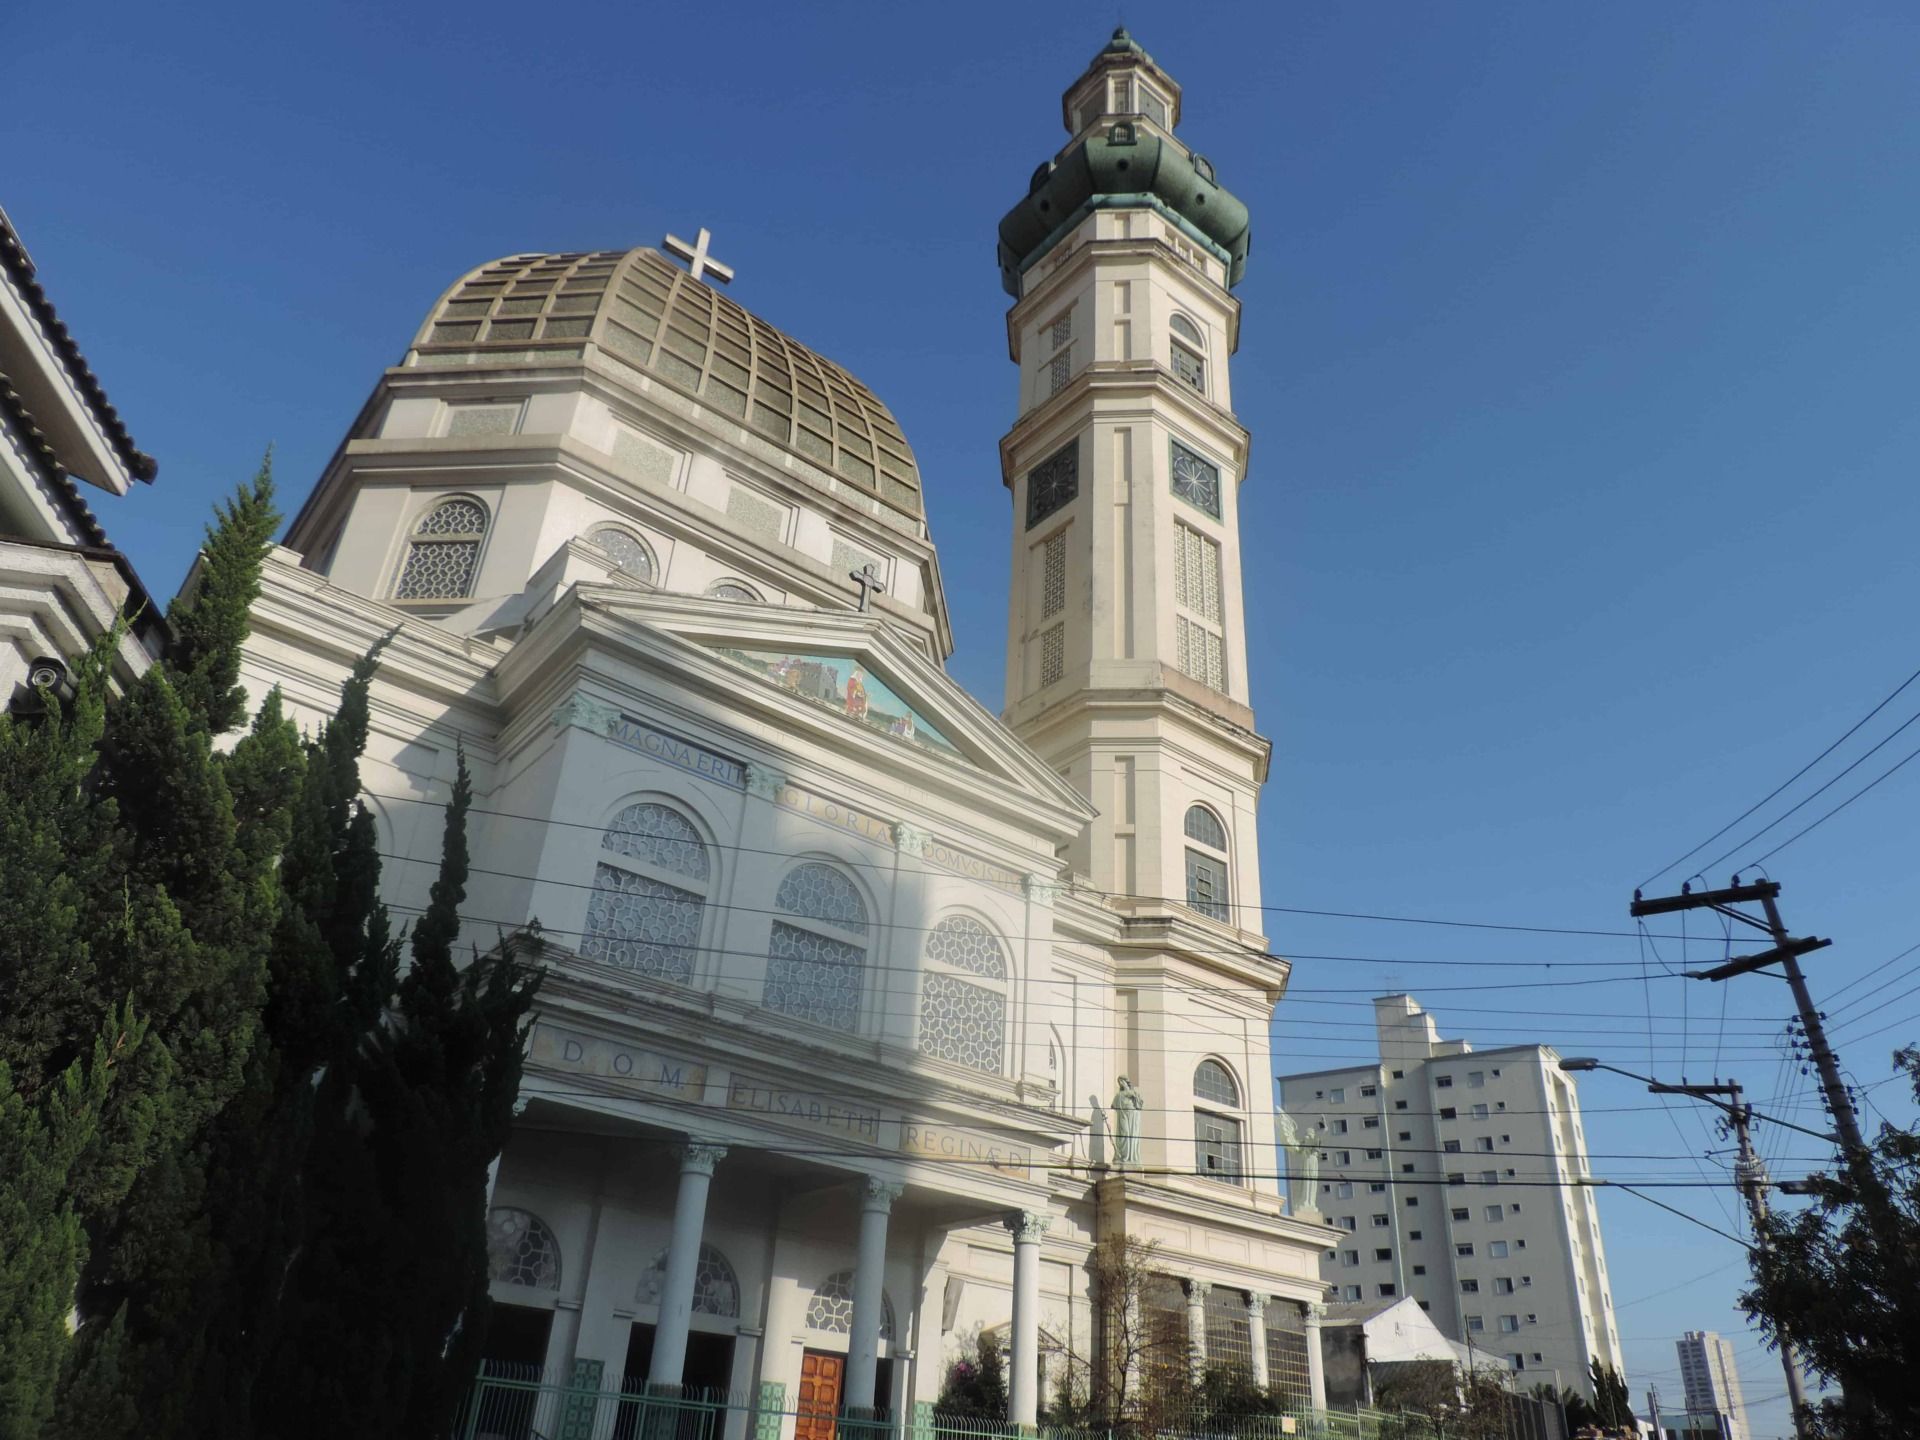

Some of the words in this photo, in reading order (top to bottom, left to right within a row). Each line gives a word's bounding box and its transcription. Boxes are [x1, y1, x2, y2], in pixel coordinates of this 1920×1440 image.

[609, 718, 691, 765] MAGNA
[696, 753, 743, 785] ERIT
[784, 789, 890, 842] GLORIA
[563, 1039, 585, 1065] D.
[613, 1053, 635, 1077] O.
[660, 1064, 684, 1091] M.
[732, 1085, 874, 1135] ELISABETH
